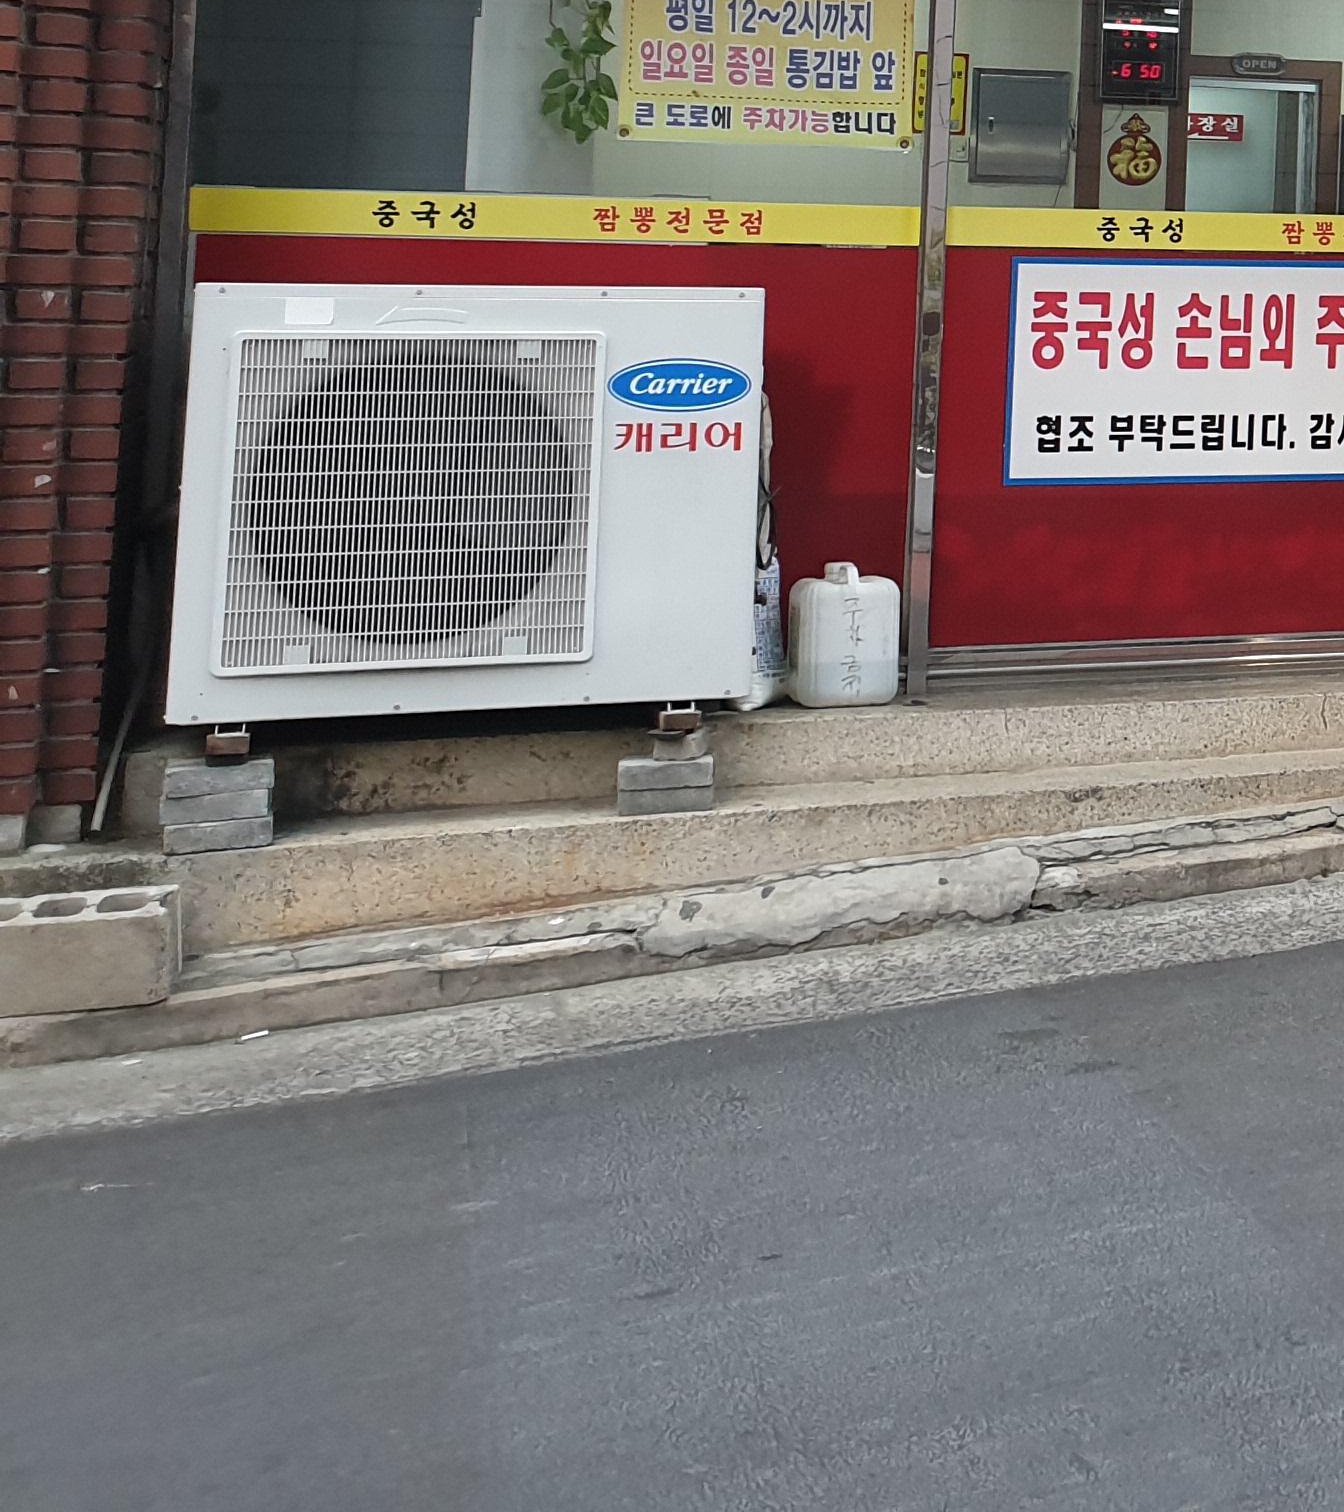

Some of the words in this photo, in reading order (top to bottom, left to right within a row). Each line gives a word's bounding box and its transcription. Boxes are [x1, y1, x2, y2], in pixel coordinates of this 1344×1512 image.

[640, 40, 715, 82] 일요일
[725, 46, 775, 87] 종일
[786, 48, 860, 91] 통김밥
[871, 51, 895, 91] 앞
[1242, 59, 1277, 69] OPEN
[634, 102, 655, 126] 큰
[666, 104, 731, 130] 도로에
[743, 107, 897, 136] 주차가능합니다
[1188, 115, 1238, 132] 장실
[373, 199, 478, 230] 중국성
[592, 205, 765, 236] 짬뽕전문점
[1096, 216, 1185, 243] 중국성
[1031, 291, 1155, 370] 중국성
[1175, 293, 1295, 370] 손님외
[628, 371, 734, 397] Carrier
[614, 421, 743, 452] 캐리어
[1035, 413, 1094, 453] 협조
[1109, 411, 1295, 452] 부탁드립니다.
